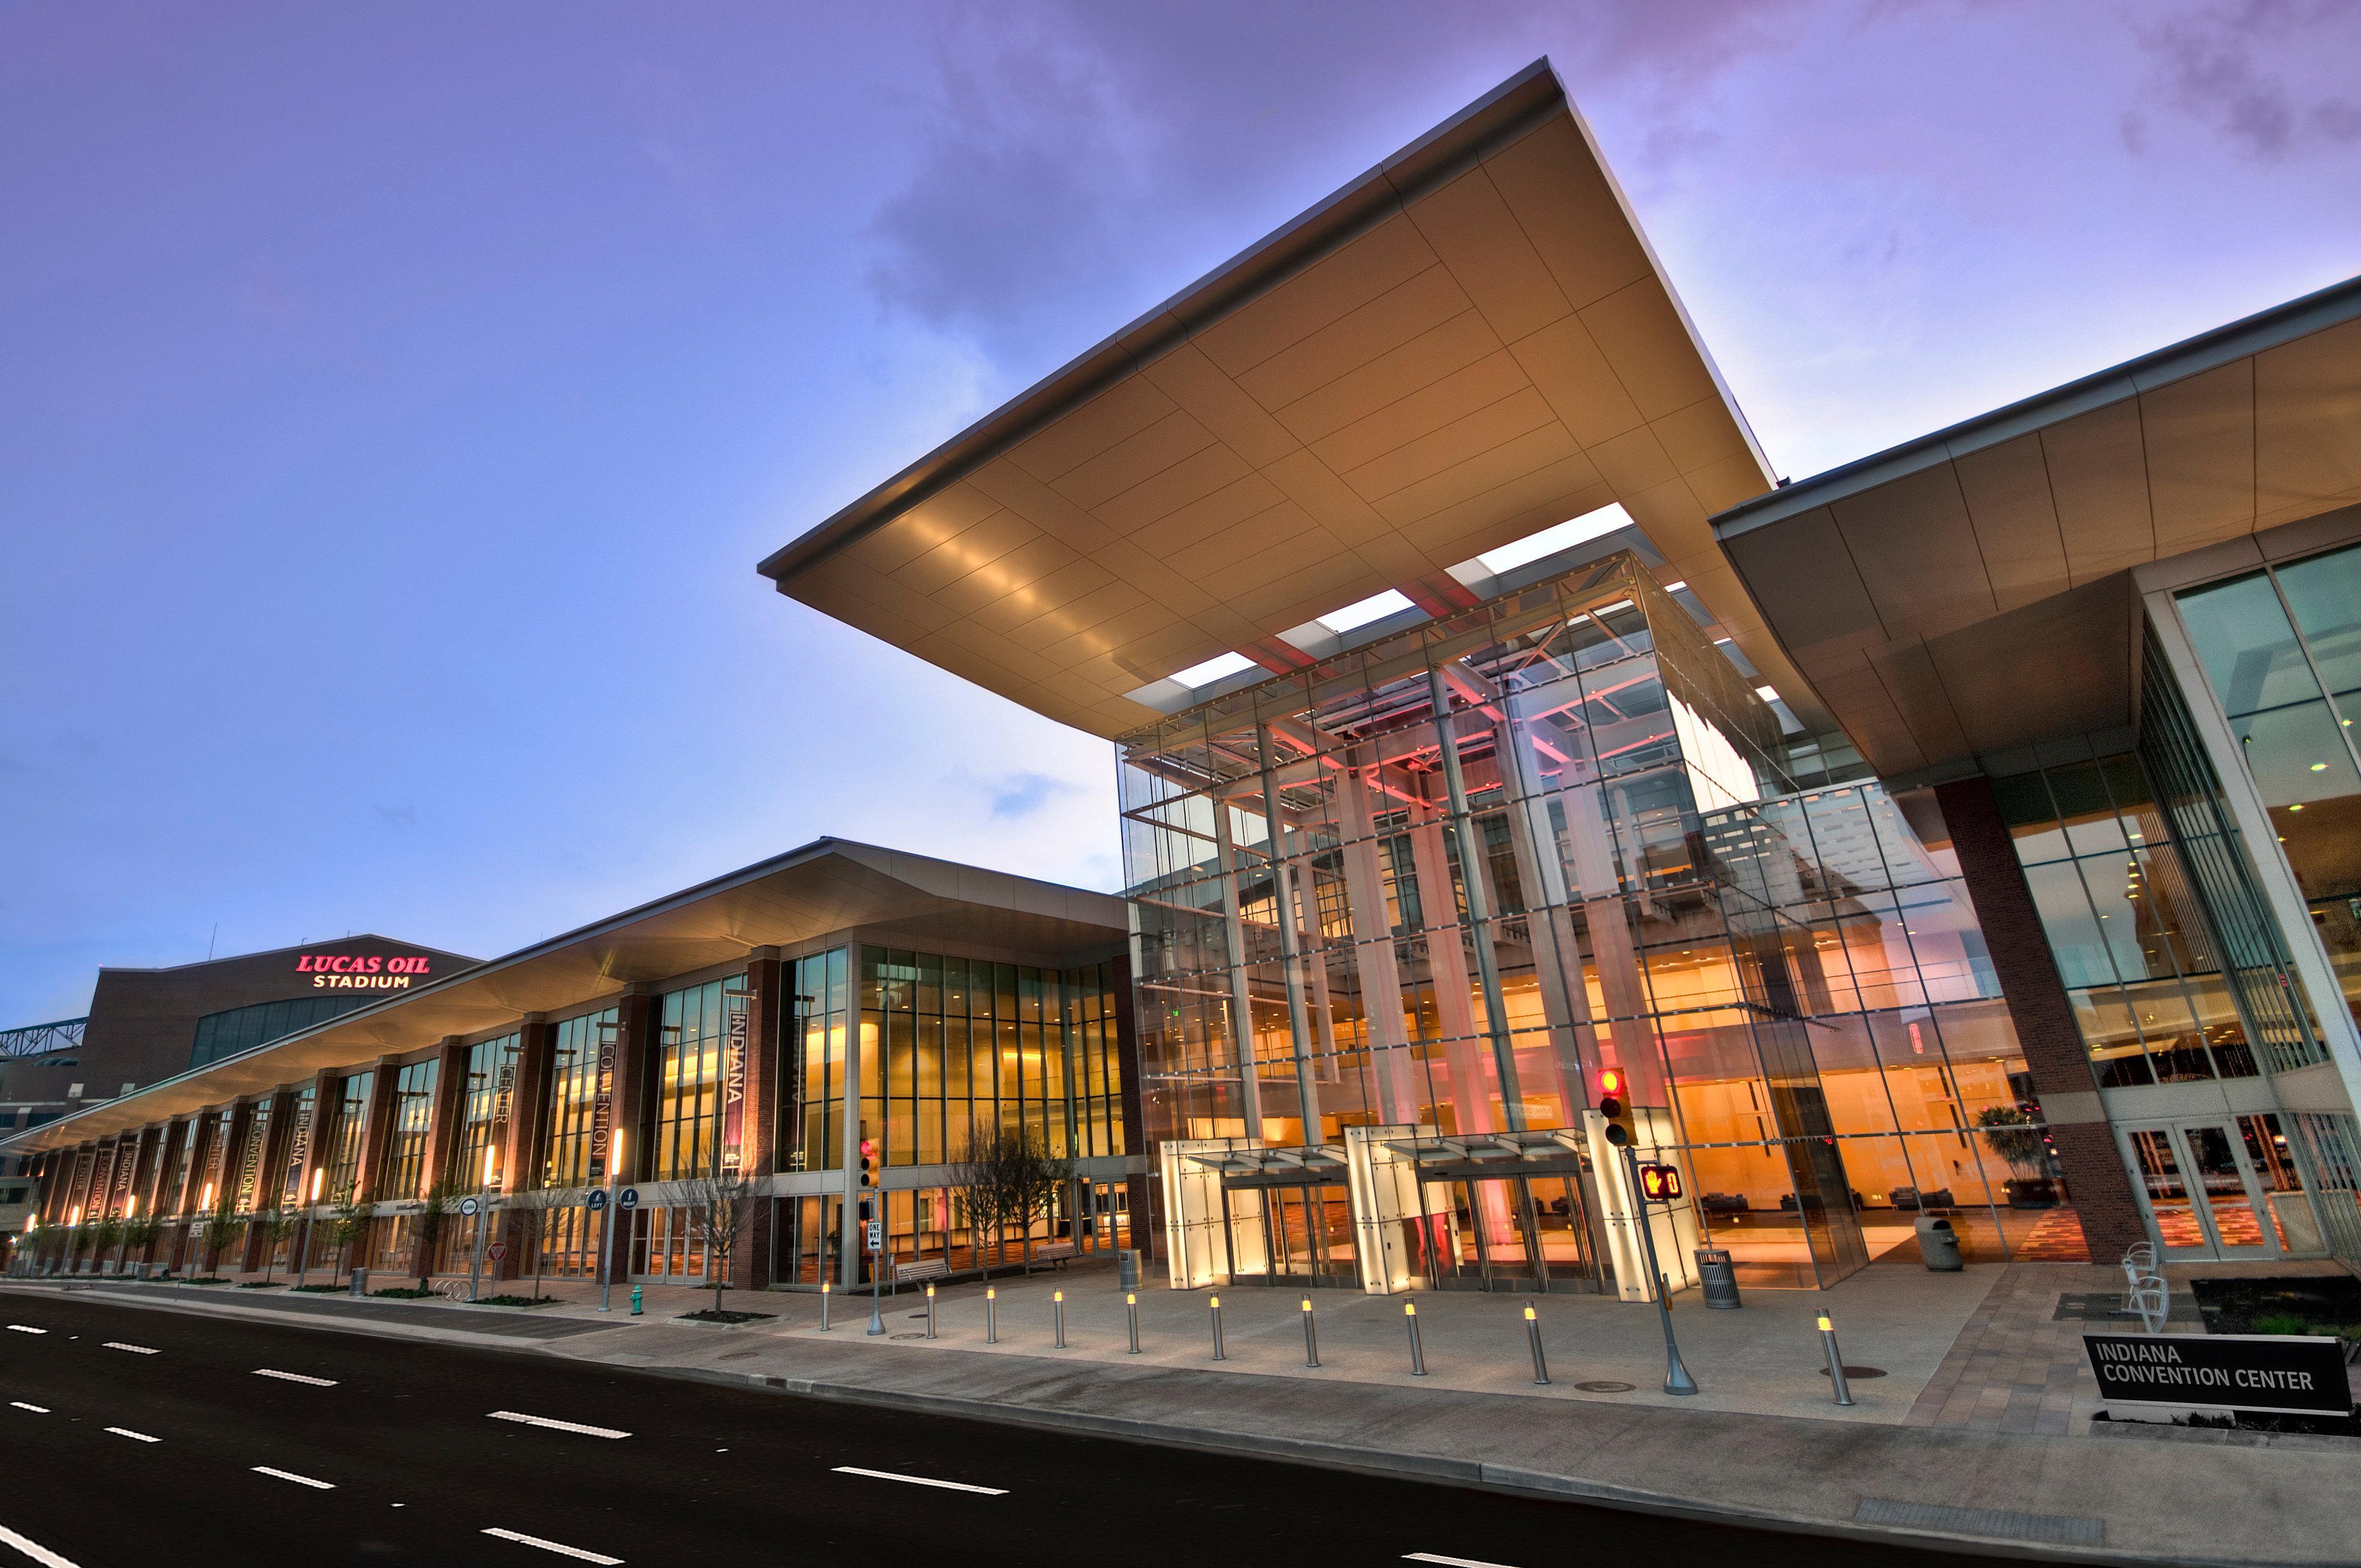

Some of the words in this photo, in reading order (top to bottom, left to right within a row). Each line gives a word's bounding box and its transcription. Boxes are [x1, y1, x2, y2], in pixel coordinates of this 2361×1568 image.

[295, 955, 382, 973] LUCAS
[387, 957, 430, 974] OIL
[313, 975, 409, 988] STADIUM
[727, 1015, 745, 1104] INDIANA
[495, 1068, 512, 1123] CENTER
[592, 1044, 615, 1156] CONVENTION
[208, 1131, 227, 1170] CENTER
[241, 1123, 264, 1192] CONVENTION
[291, 1113, 310, 1167] INDIANA
[76, 1161, 90, 1190] CENTER
[91, 1157, 111, 1208] CONVENTION
[117, 1153, 134, 1191] INDIANA
[1667, 1173, 1678, 1193] 0
[2096, 1343, 2182, 1364] INDIANA
[2103, 1364, 2230, 1386] CONVENTION
[2235, 1369, 2314, 1391] CENTER
